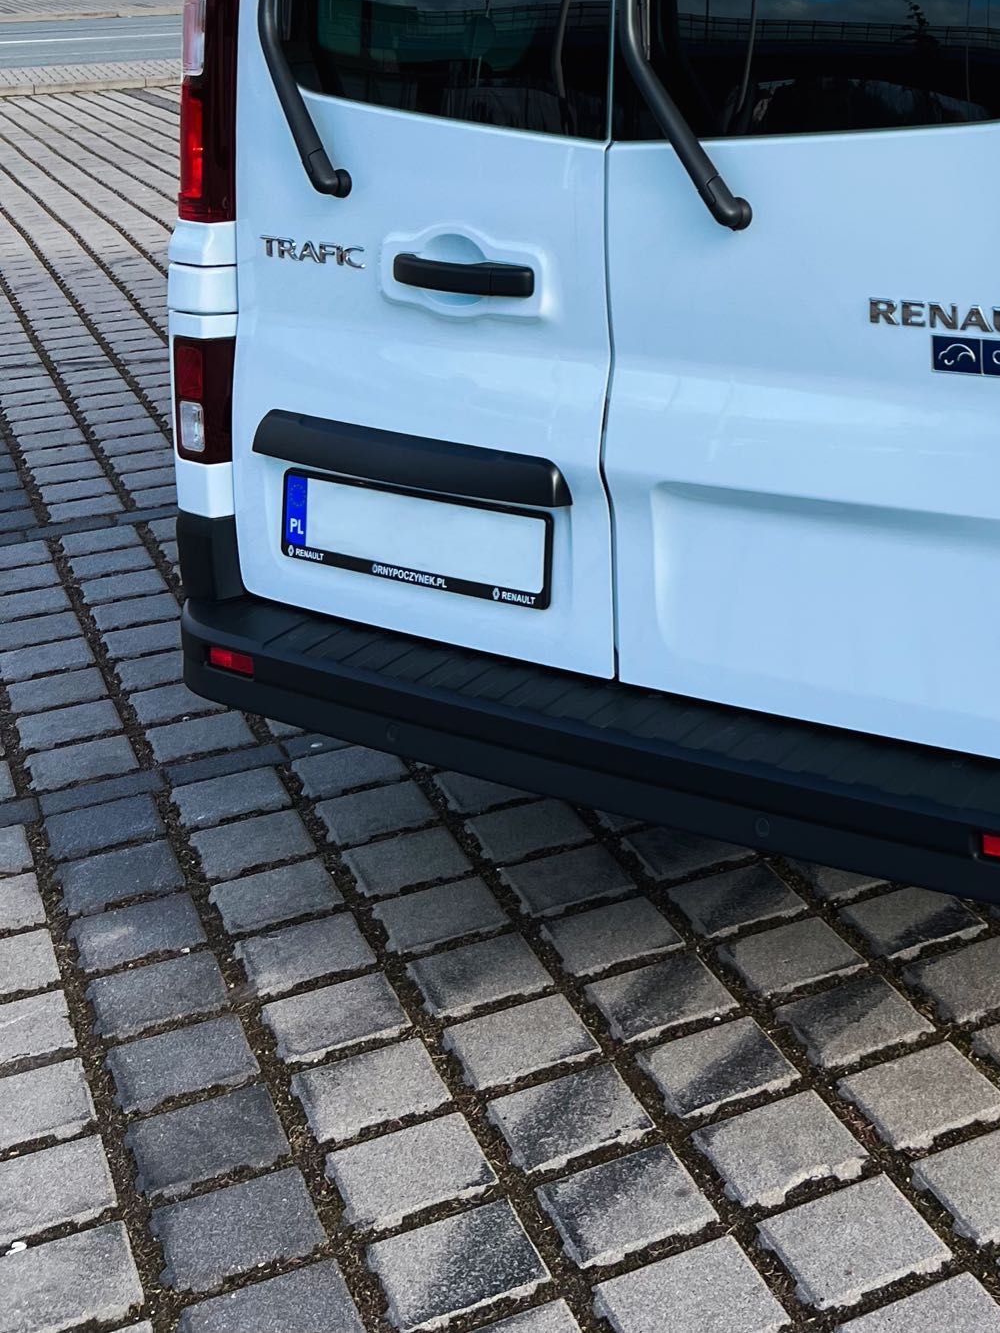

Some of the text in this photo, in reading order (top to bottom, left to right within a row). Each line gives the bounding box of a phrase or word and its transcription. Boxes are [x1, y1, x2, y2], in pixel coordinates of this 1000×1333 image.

[260, 234, 366, 269] TRAFIC
[289, 517, 304, 536] PL
[295, 548, 324, 562] RENAULT
[501, 590, 536, 606] RENAULT
